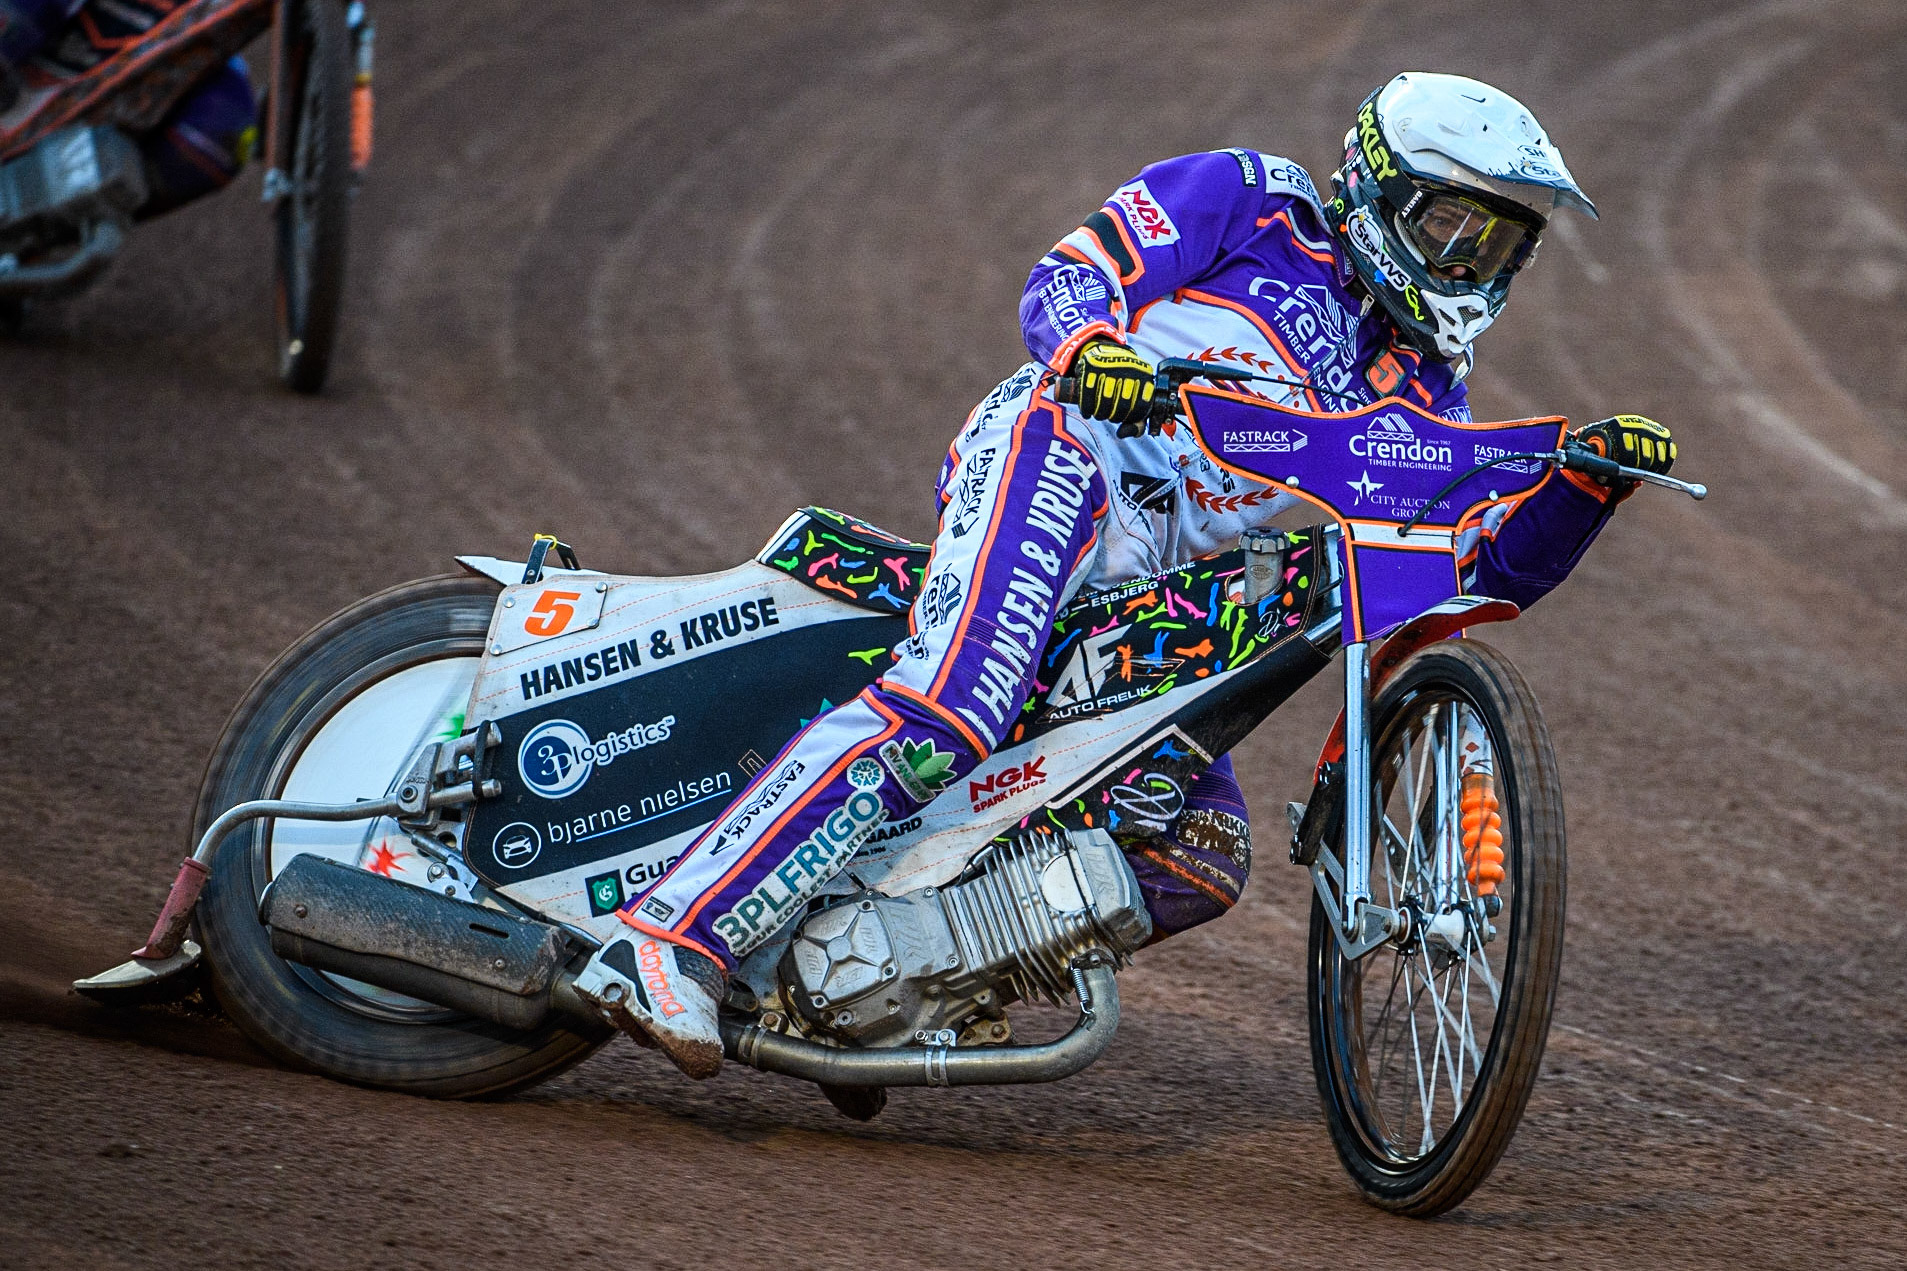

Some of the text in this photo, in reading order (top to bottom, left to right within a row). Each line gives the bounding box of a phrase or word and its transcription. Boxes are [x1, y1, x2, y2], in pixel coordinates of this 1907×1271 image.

[1121, 189, 1171, 240] NGK
[1273, 310, 1312, 365] TIMBER
[1368, 351, 1405, 394] 5
[1223, 430, 1290, 443] FASTRACK
[1348, 434, 1453, 464] Crendon
[963, 447, 996, 517] FATRACK
[1367, 458, 1452, 472] TIMBER ENGINEERING
[1370, 494, 1450, 510] CITY AUCTON
[971, 439, 1099, 725] HANSEN & KRUSE
[1091, 580, 1159, 608] ESBJERG
[524, 589, 582, 637] 5
[520, 596, 780, 701] HANSEN & KRUSE
[1049, 684, 1152, 723] AUTO FRELIK
[730, 760, 806, 841] FASTRACK
[968, 755, 1048, 803] NGK
[973, 778, 1047, 813] SPARK PLUGS
[547, 771, 732, 844] bjarne nielsen
[775, 868, 832, 925] COOLEST
[834, 809, 890, 868] PARTNER
[638, 939, 688, 1021] daytona
